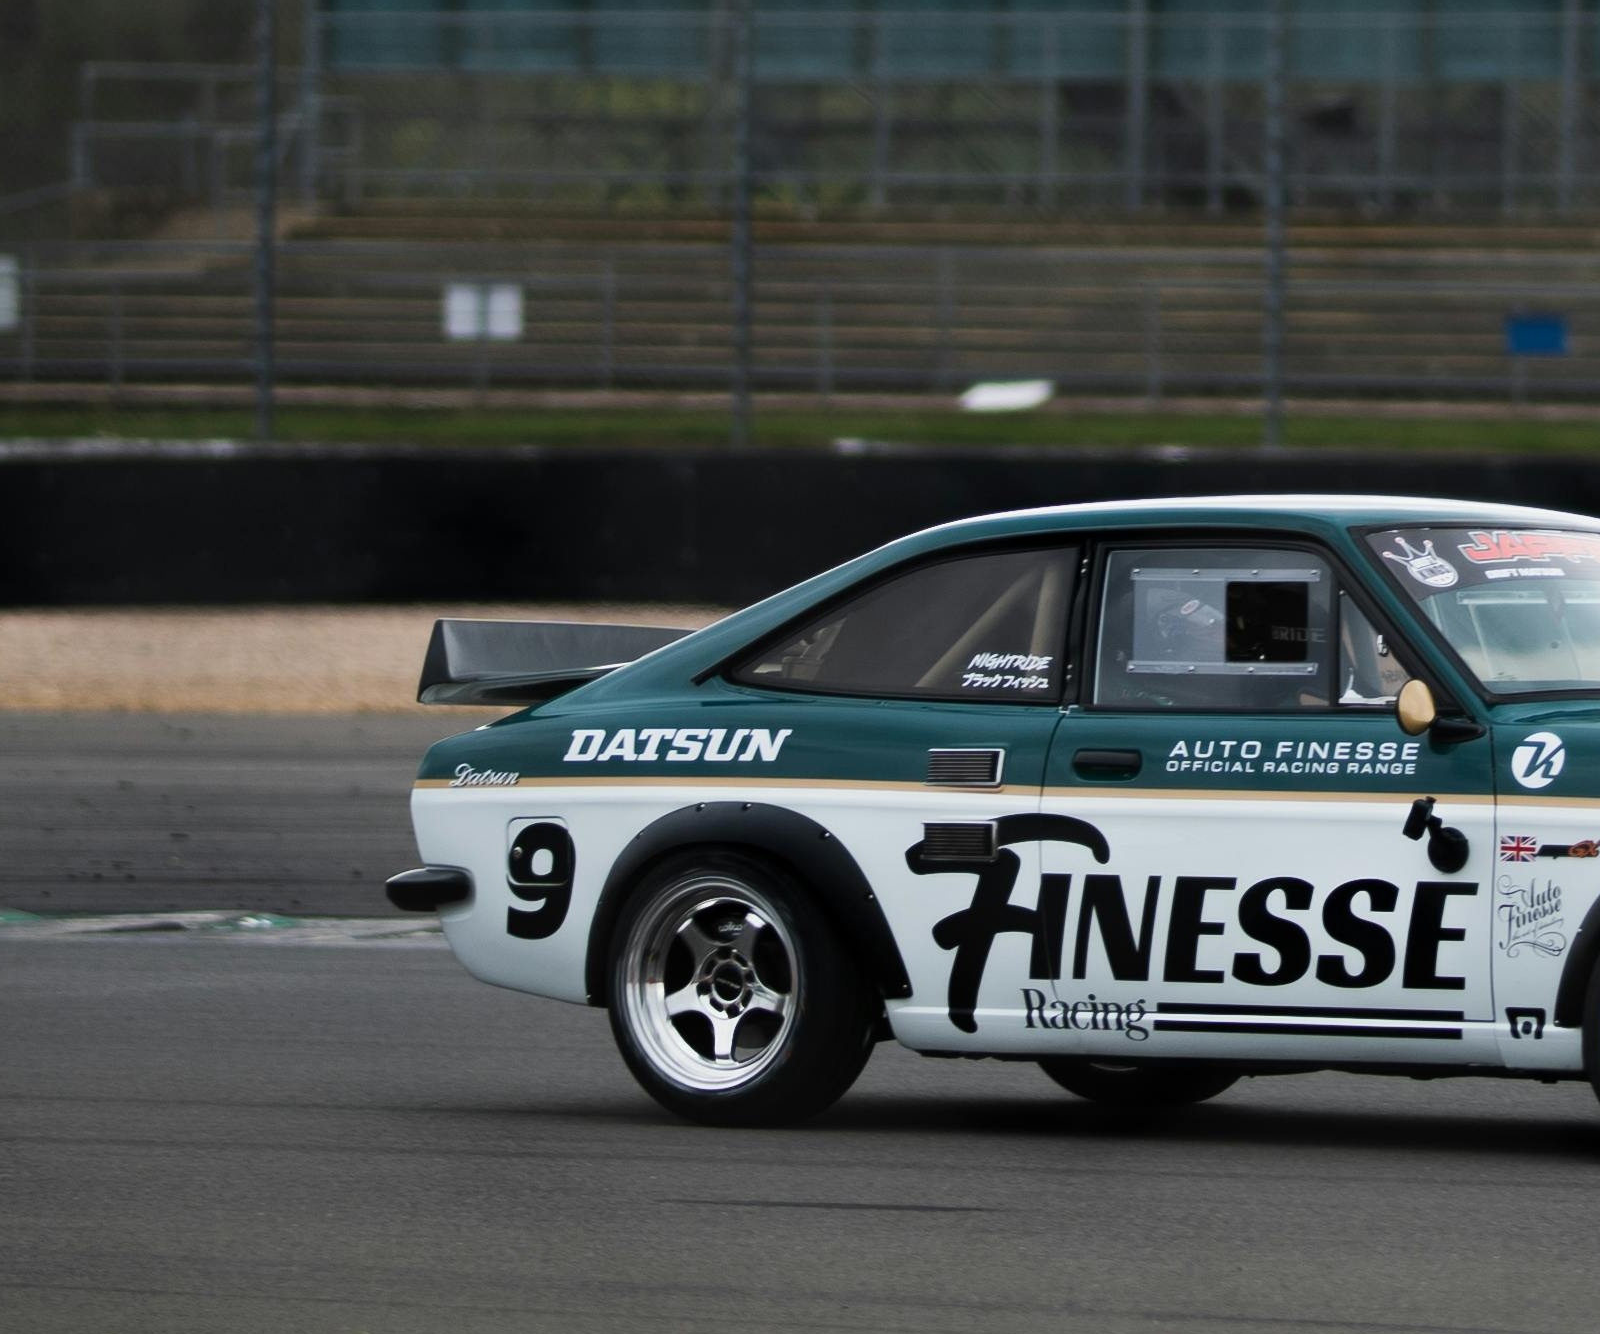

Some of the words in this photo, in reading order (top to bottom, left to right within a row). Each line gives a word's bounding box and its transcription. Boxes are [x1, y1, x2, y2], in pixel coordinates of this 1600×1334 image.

[967, 652, 1054, 671] NIGHTRIDE
[563, 728, 793, 762] DATSUN
[1168, 740, 1263, 759] AUTO
[1275, 741, 1422, 761] FINESSE
[449, 763, 520, 787] Datsun
[1165, 760, 1256, 774] OFFICIAL
[1262, 761, 1340, 775] RACING
[1346, 762, 1417, 775] RANGE
[506, 821, 577, 940] 9
[904, 812, 1480, 1034] FINESSE
[1498, 899, 1562, 950] Finesse
[1019, 988, 1149, 1042] Racing
